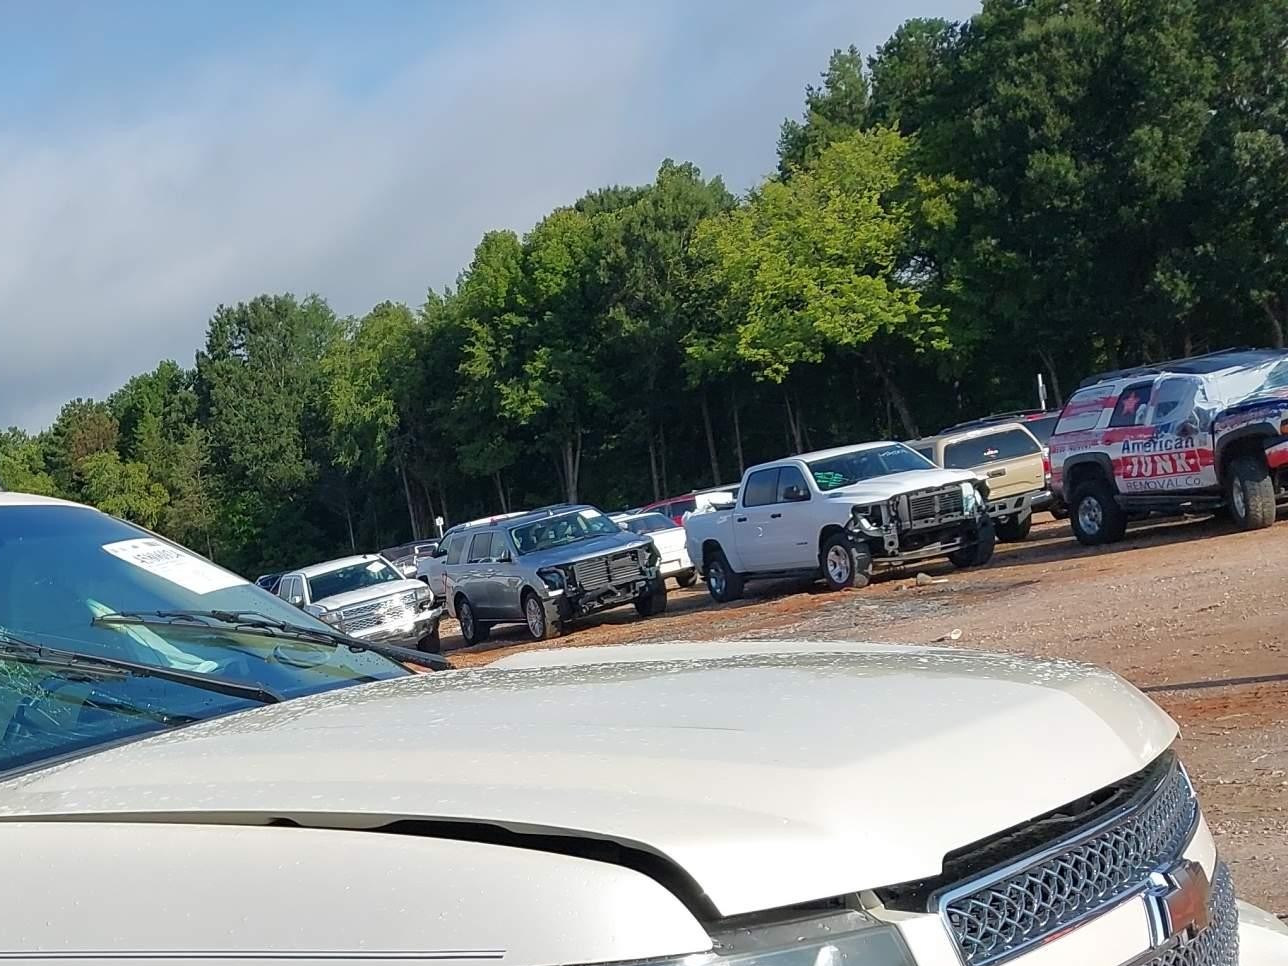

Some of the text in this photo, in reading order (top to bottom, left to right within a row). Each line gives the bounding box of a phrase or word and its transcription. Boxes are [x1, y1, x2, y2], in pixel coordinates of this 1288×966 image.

[1122, 436, 1194, 454] American
[1130, 453, 1192, 477] JUNK
[1126, 478, 1182, 491] REMOVAL
